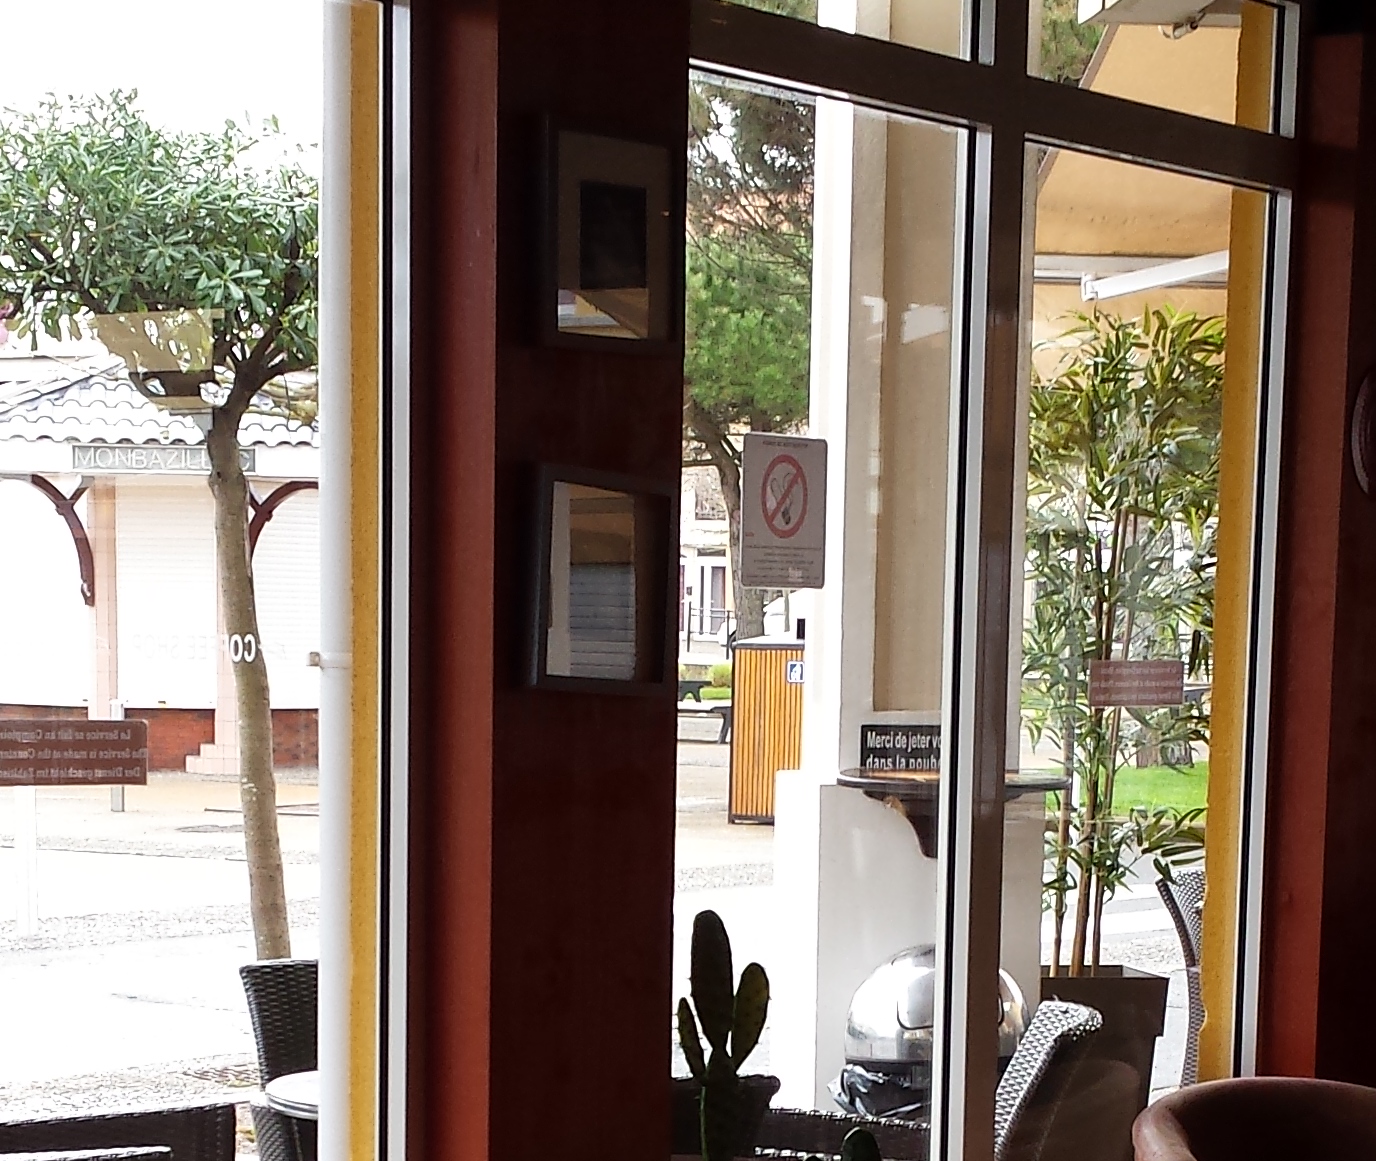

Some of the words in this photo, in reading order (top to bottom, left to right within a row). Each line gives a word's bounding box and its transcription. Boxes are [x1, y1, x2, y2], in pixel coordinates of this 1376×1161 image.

[74, 446, 251, 471] MONBAZILLC
[866, 730, 894, 749] Merci
[894, 730, 907, 749] de
[906, 730, 931, 753] jeter
[865, 753, 893, 769] dans
[895, 753, 906, 769] la
[908, 754, 942, 769] poub
